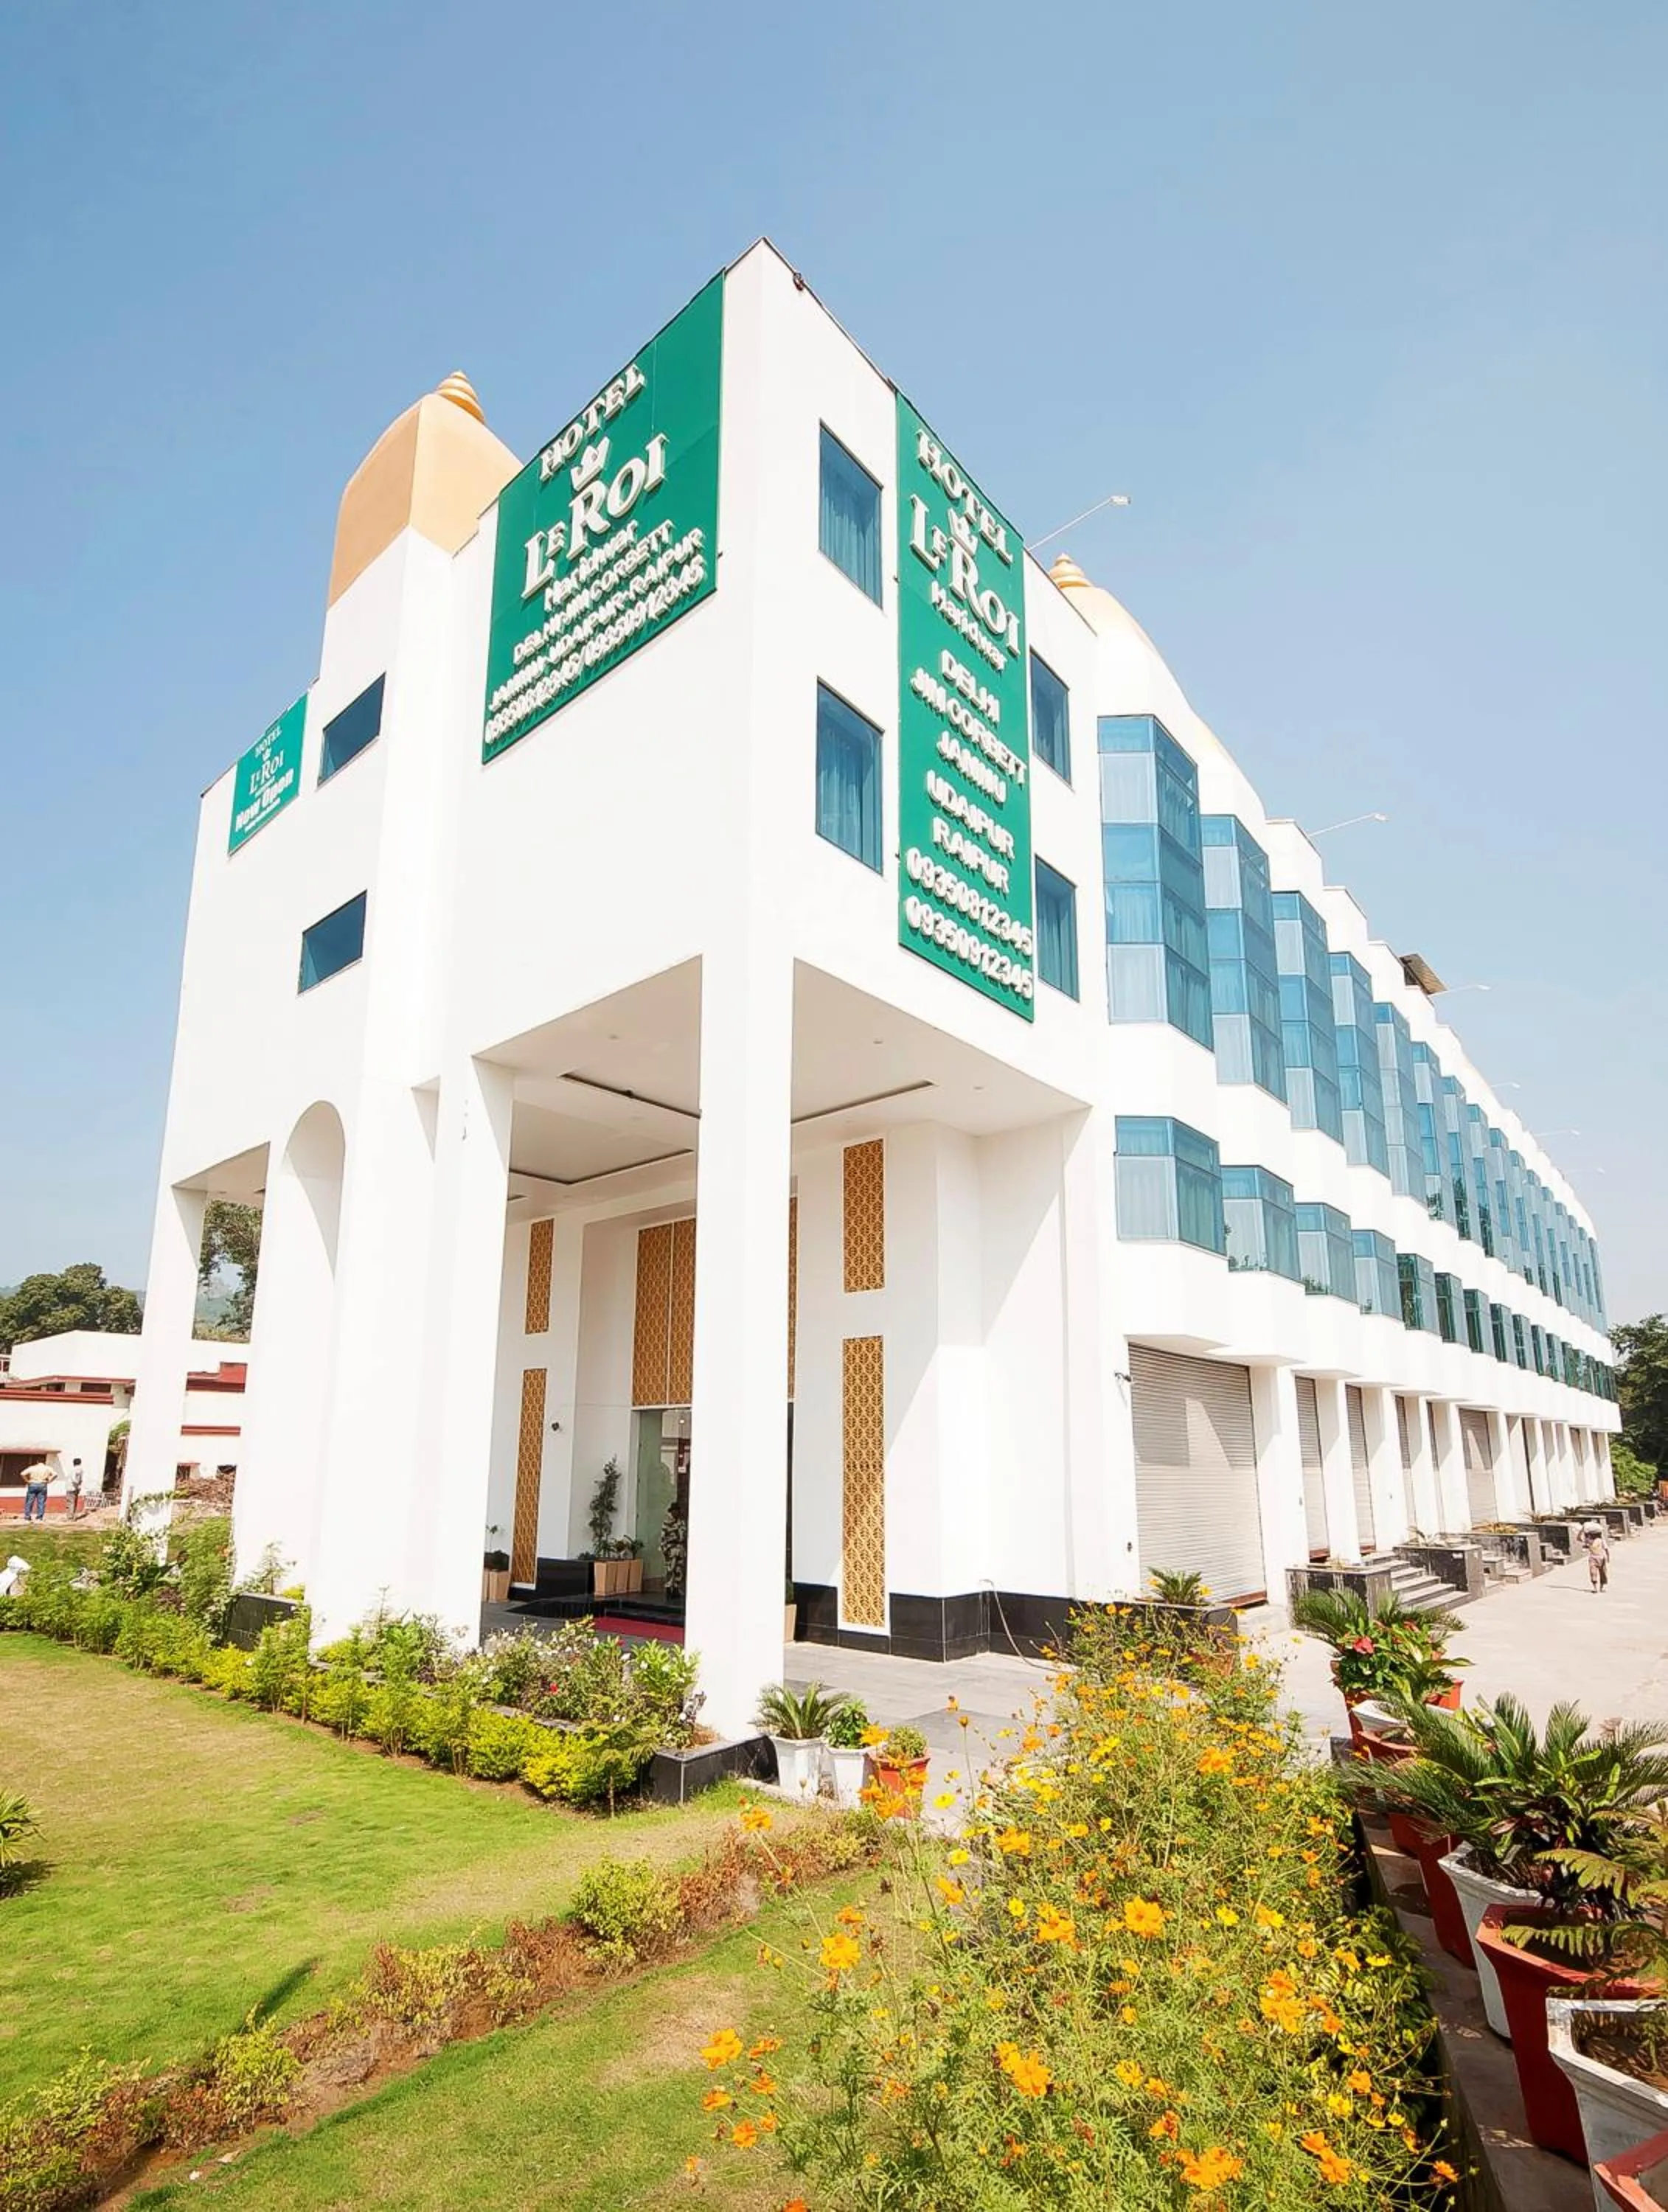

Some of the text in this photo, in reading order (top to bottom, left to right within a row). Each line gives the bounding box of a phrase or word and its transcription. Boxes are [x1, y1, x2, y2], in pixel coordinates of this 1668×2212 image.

[540, 364, 646, 481] HOTEL
[915, 428, 1012, 565] HOTEL
[544, 519, 638, 611] Haridwar
[589, 519, 674, 602] CORBETT
[931, 581, 1007, 671] Haridwar
[910, 667, 1026, 785] JIM CORBETT
[941, 649, 1000, 723] DELHI
[255, 726, 282, 758] HOTEL
[936, 731, 1006, 804] JAMMU
[927, 769, 1015, 859] UDAIPUR
[933, 816, 1010, 894] RAIPUR
[906, 847, 1032, 956] 09350812345
[905, 895, 1033, 1000] 09350912345
